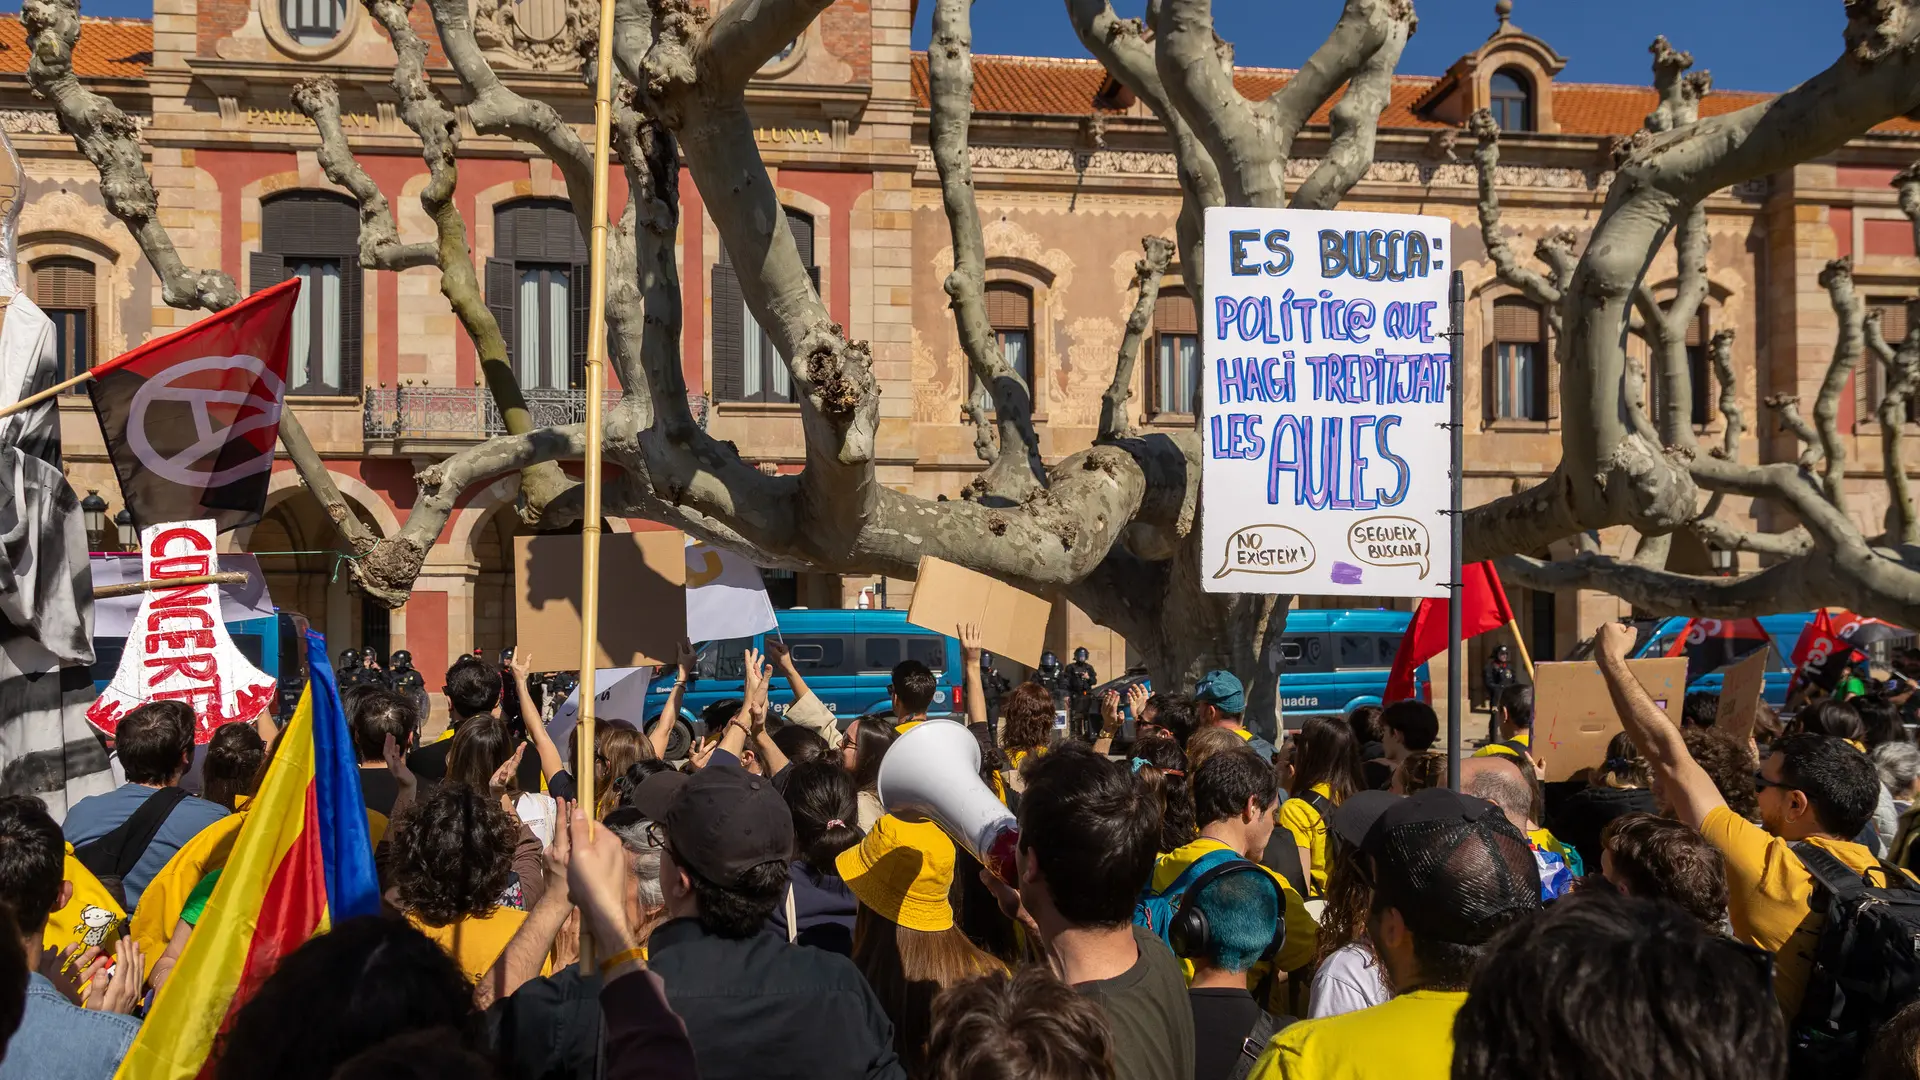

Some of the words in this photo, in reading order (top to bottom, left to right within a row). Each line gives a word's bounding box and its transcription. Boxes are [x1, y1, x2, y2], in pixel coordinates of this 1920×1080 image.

[246, 107, 371, 129] PARLANT
[759, 127, 823, 144] LUNYA
[1229, 229, 1294, 277] ES
[1318, 229, 1444, 282] BUSCA:
[1383, 301, 1438, 344] QUE
[1211, 413, 1266, 460] LES
[1267, 414, 1410, 511] AULES
[1237, 533, 1263, 550] NO
[1803, 637, 1833, 676] CGT
[1282, 695, 1319, 707] uadra
